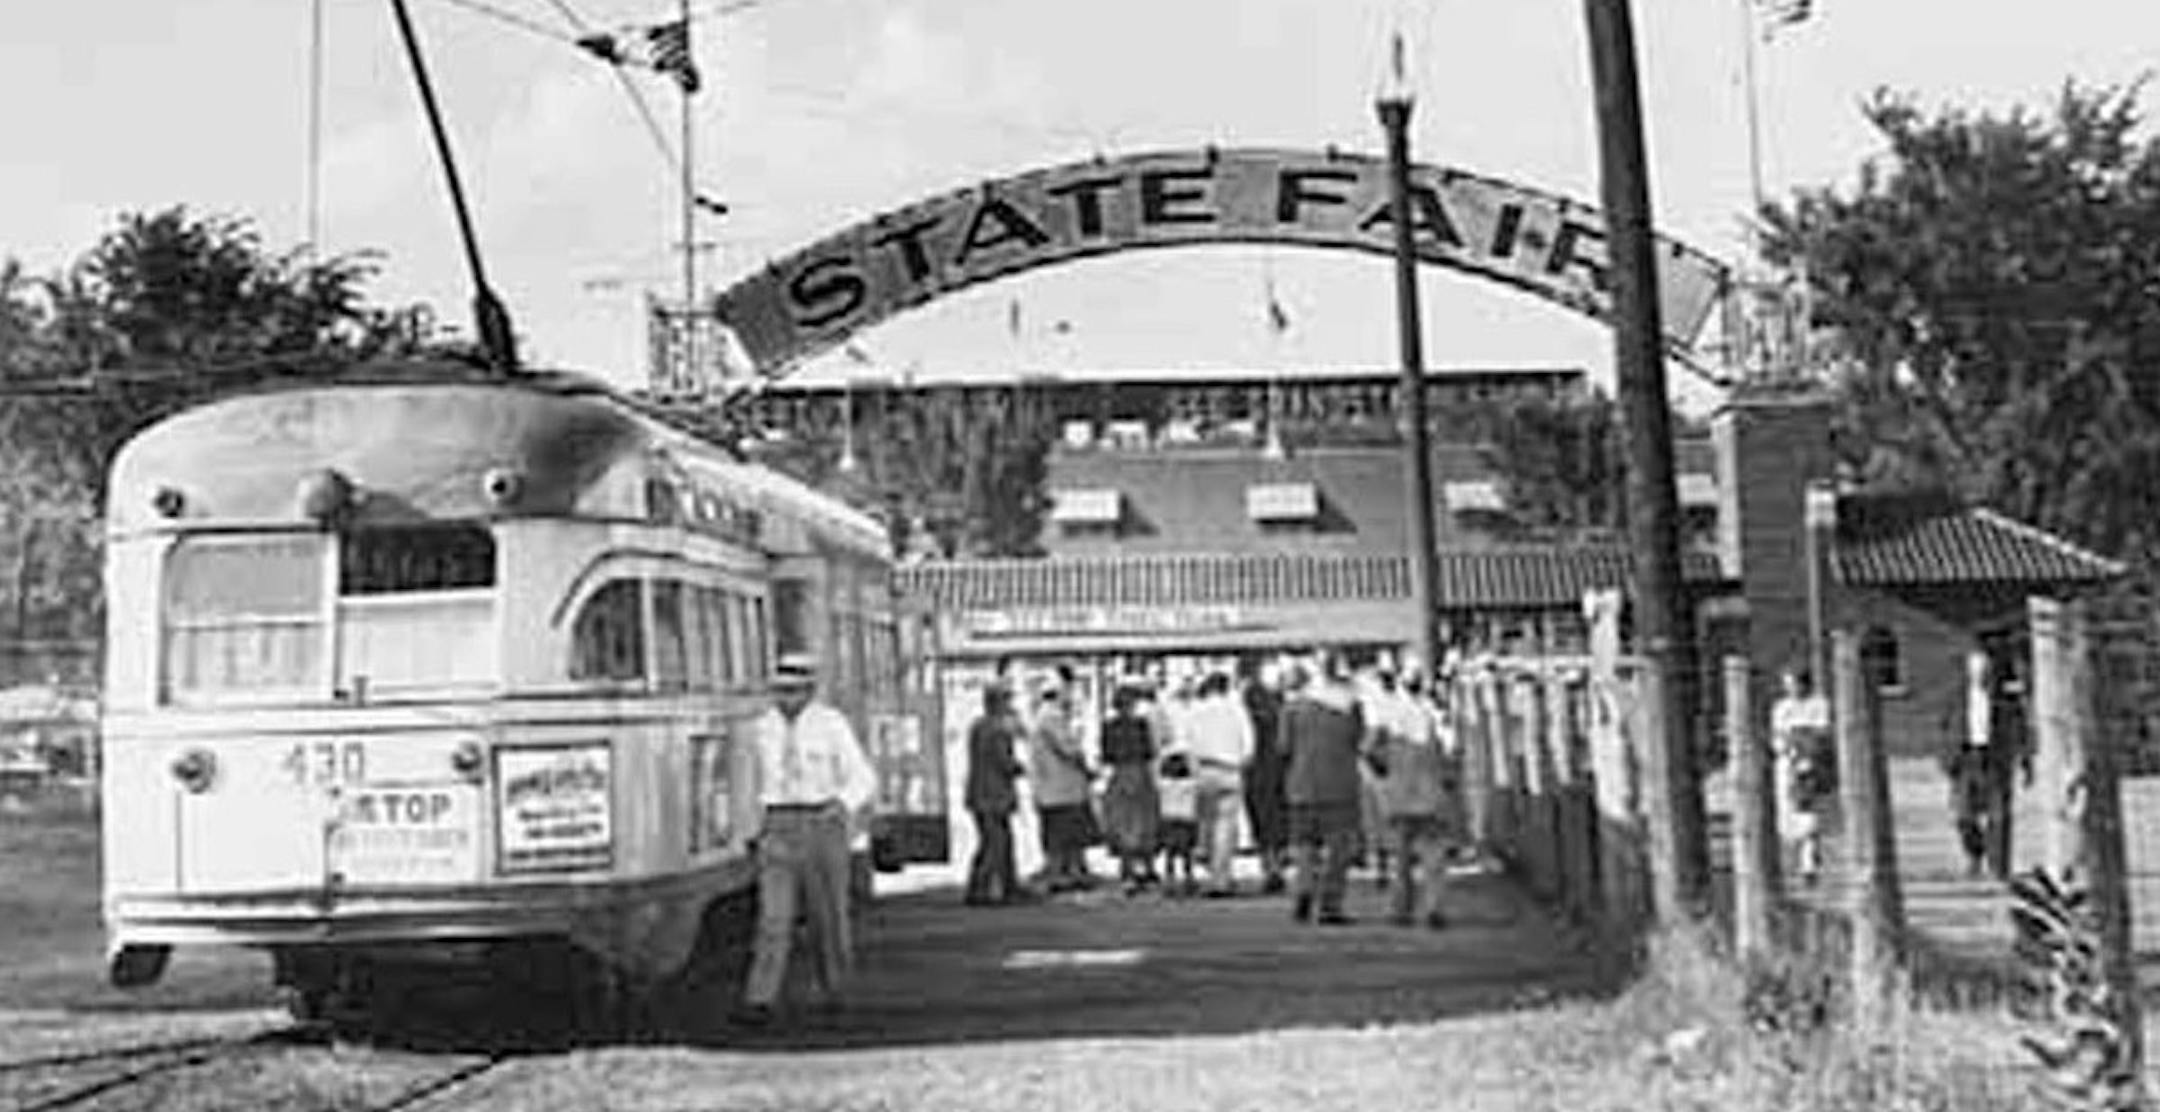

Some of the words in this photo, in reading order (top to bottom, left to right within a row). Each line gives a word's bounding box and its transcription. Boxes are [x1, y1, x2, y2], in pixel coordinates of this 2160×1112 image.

[789, 166, 1216, 327] STATE
[281, 741, 365, 785] 430
[354, 793, 452, 823] STOP
